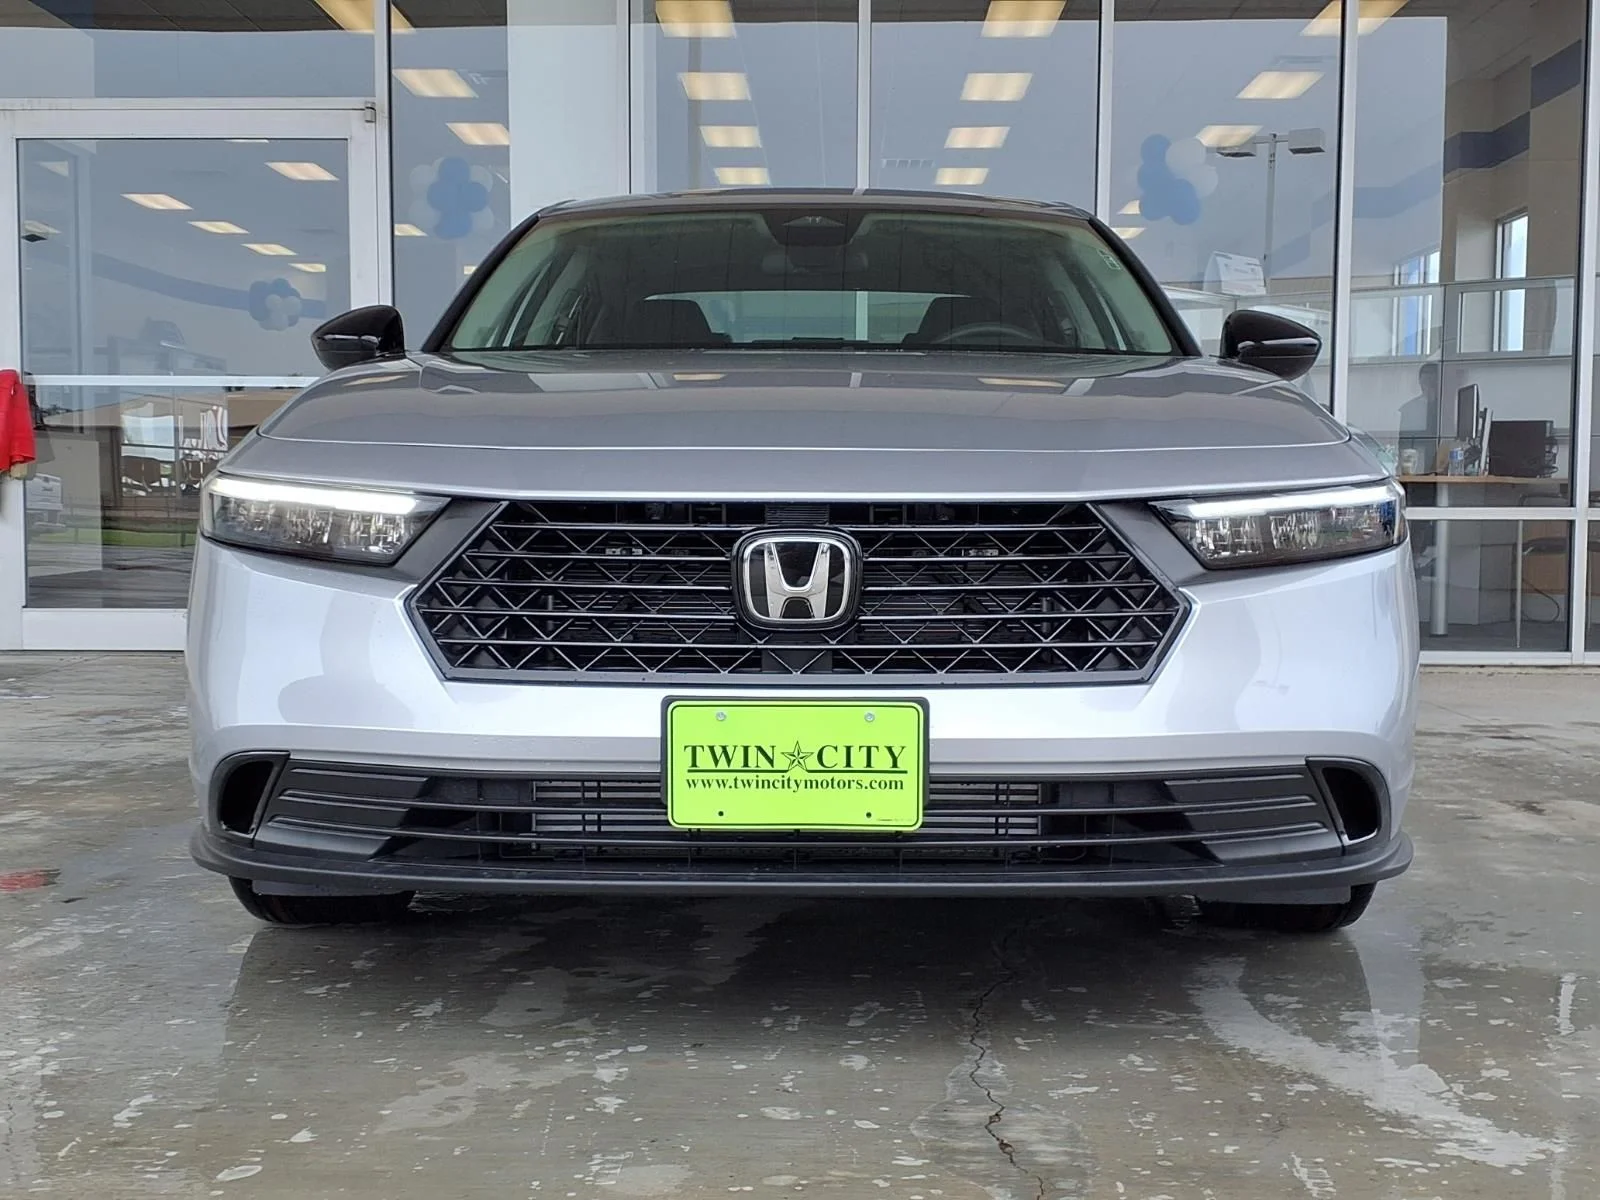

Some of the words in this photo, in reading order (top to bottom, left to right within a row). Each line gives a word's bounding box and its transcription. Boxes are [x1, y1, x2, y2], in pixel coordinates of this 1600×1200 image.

[683, 744, 776, 768] TWIN
[816, 744, 906, 769] CITY
[686, 774, 904, 793] www.twincitymotors.com
